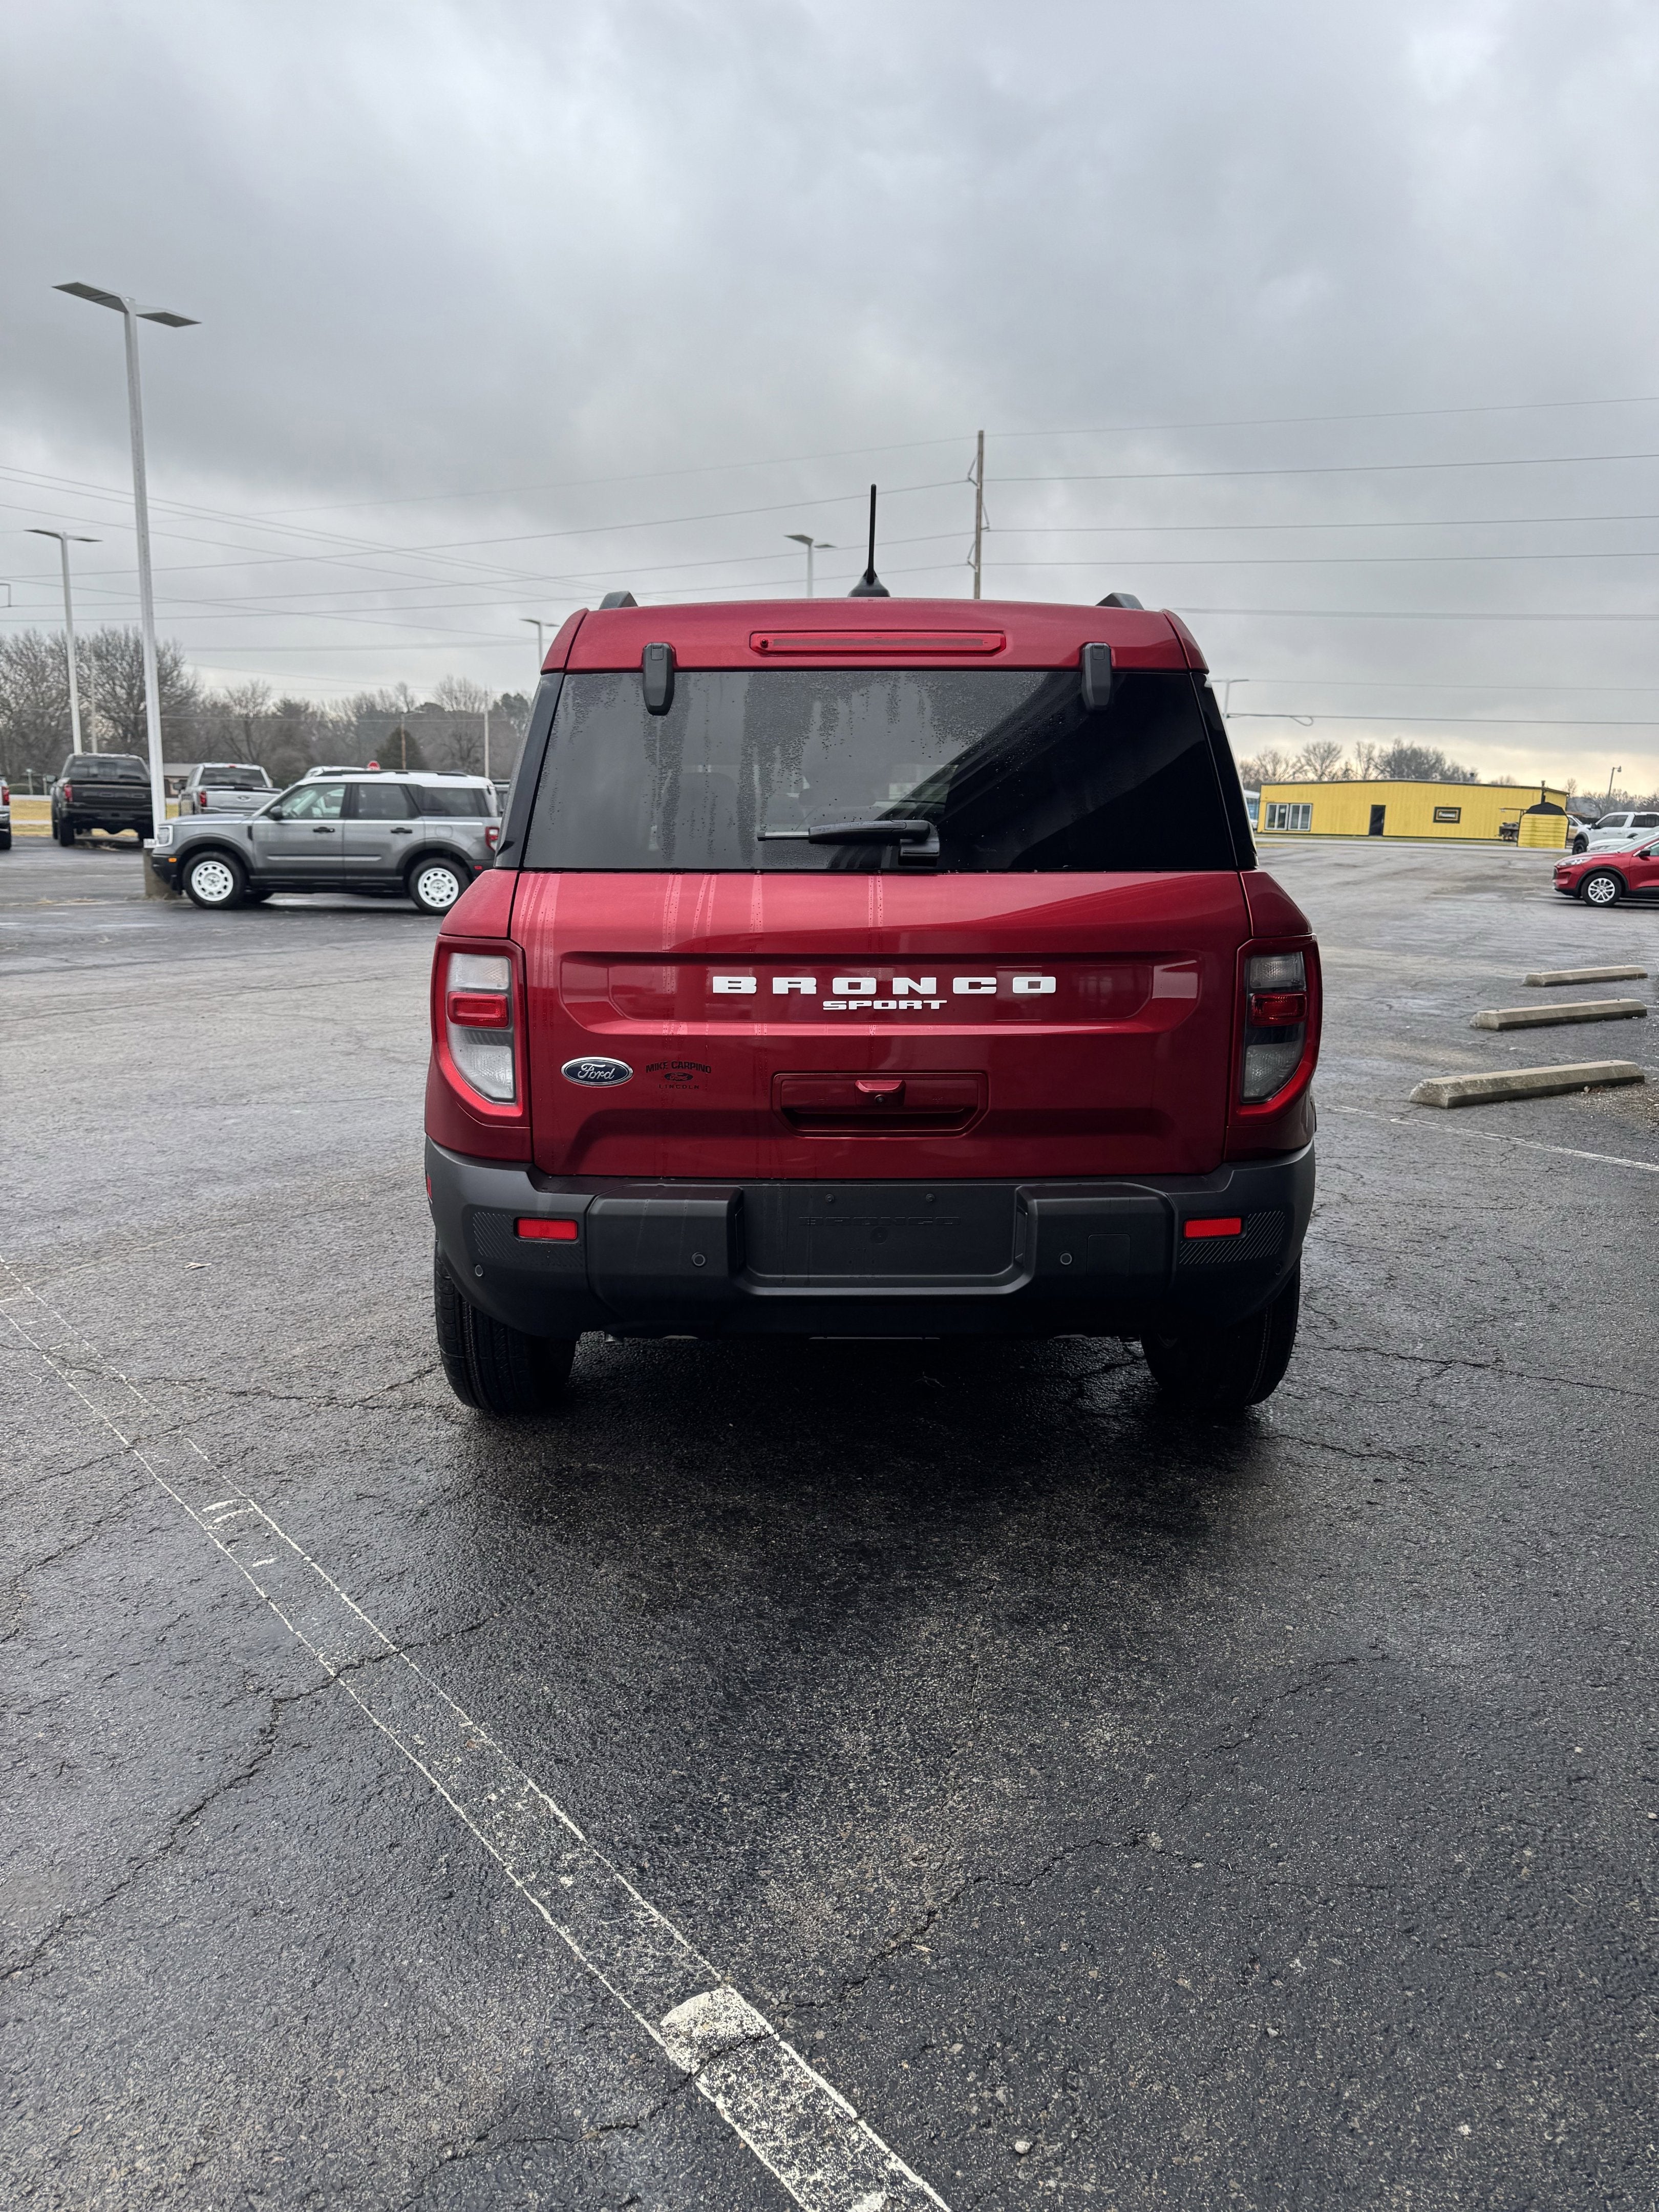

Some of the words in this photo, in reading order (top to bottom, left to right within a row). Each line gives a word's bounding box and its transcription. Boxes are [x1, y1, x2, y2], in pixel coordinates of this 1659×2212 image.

[713, 976, 1056, 994] BRONCO
[823, 1000, 947, 1010] SPORT
[578, 1062, 615, 1079] Ford
[646, 1061, 668, 1073] MIKE
[671, 1061, 712, 1073] CARPINO
